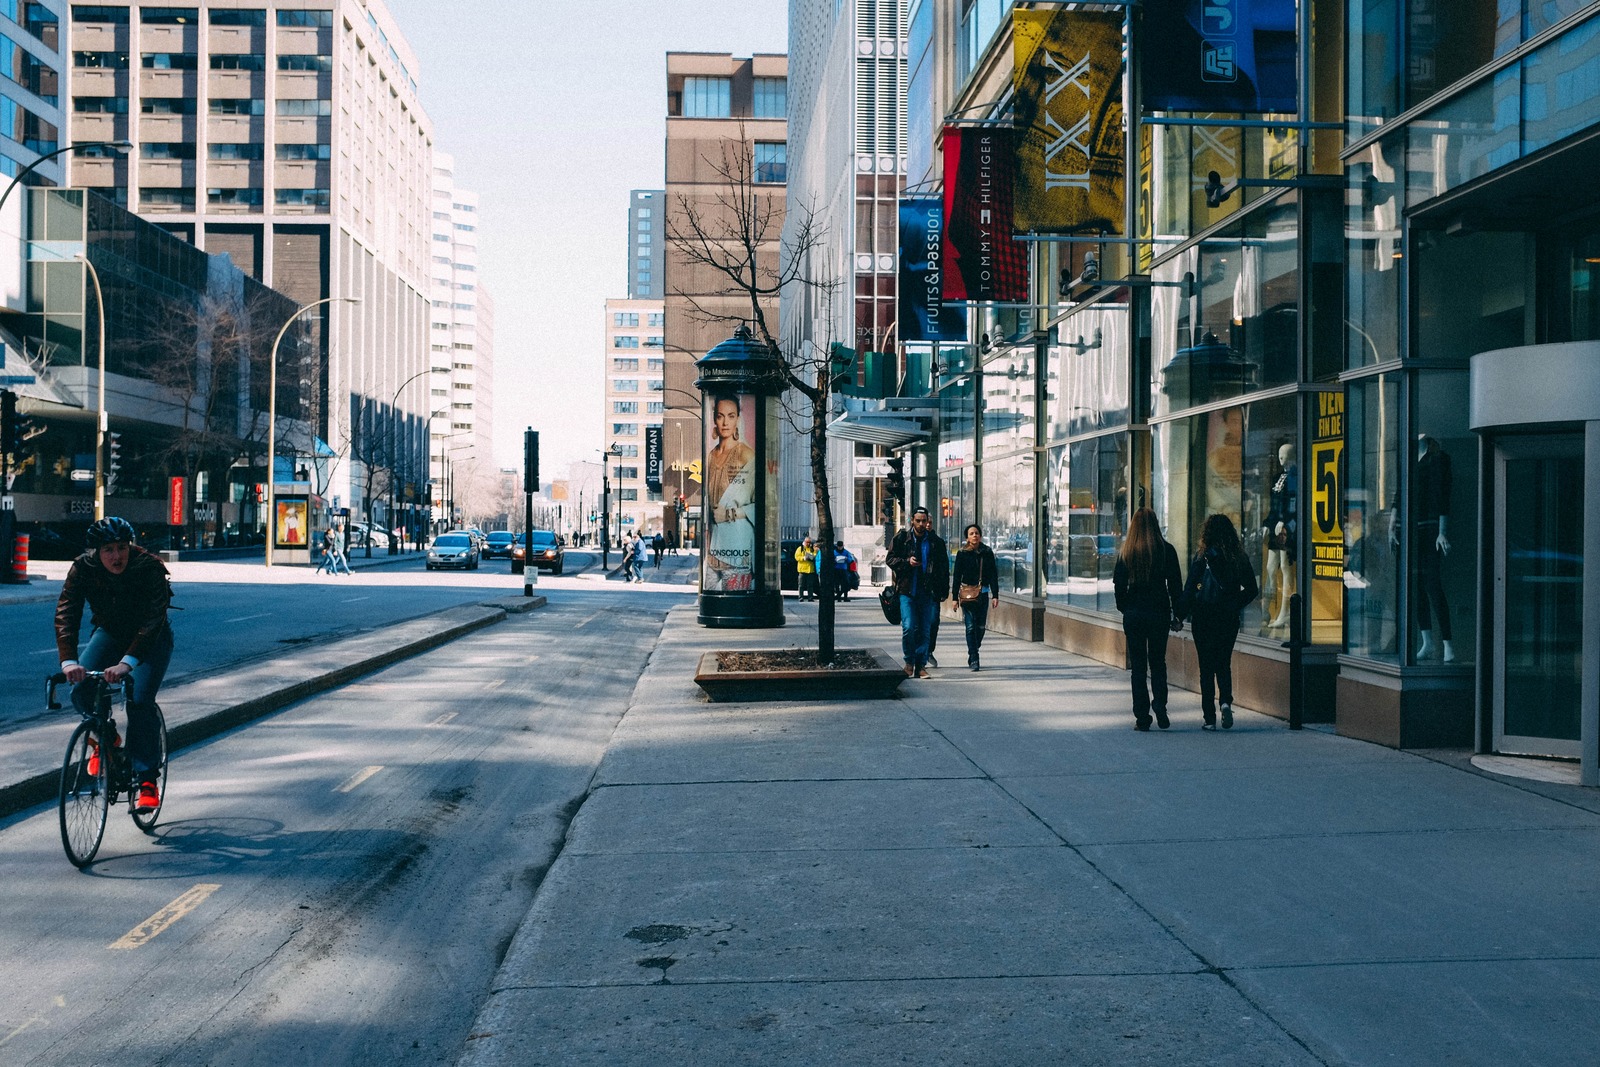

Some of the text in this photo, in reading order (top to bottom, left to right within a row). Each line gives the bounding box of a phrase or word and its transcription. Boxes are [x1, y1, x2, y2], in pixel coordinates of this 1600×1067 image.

[980, 136, 991, 292] TOMMY HILFIGER
[649, 430, 658, 474] TOPMAN
[709, 549, 750, 557] CONSCIOUS
